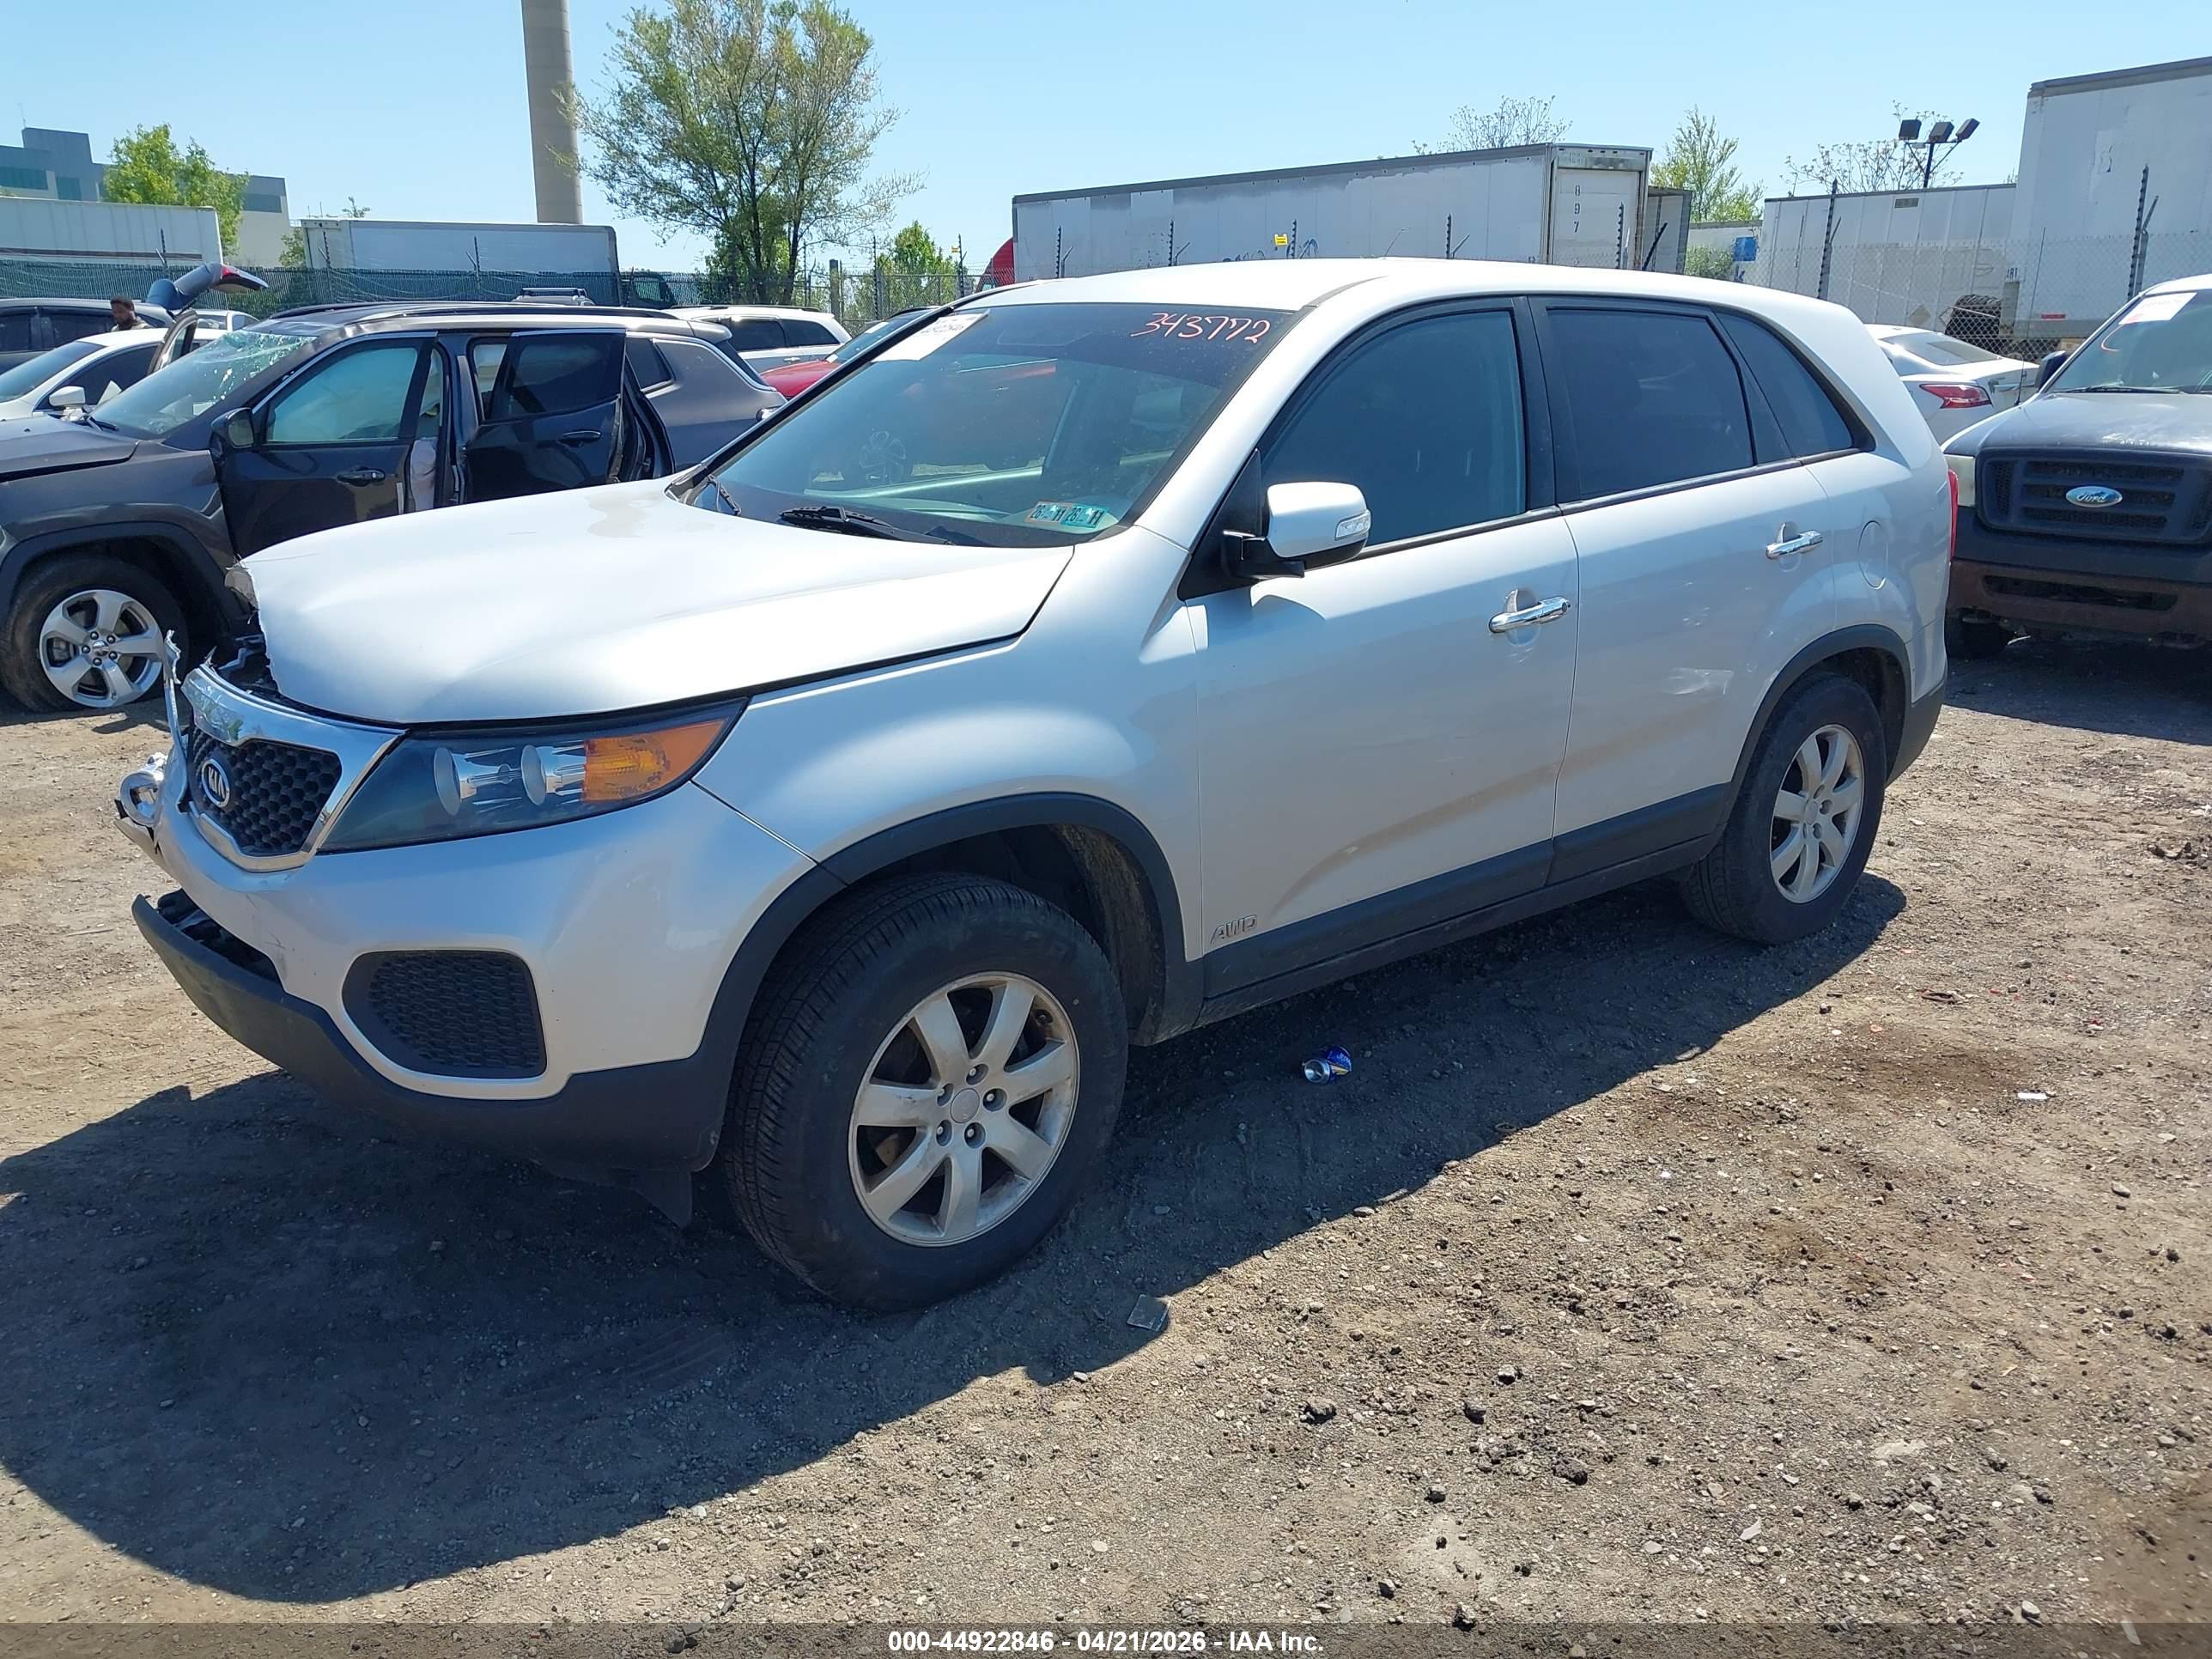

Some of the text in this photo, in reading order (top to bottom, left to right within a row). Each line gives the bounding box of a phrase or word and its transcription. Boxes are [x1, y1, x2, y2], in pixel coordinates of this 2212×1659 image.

[1130, 312, 1271, 343] 343772
[2076, 492, 2108, 503] Ford
[208, 766, 225, 799] KIA
[1210, 914, 1258, 944] AWD
